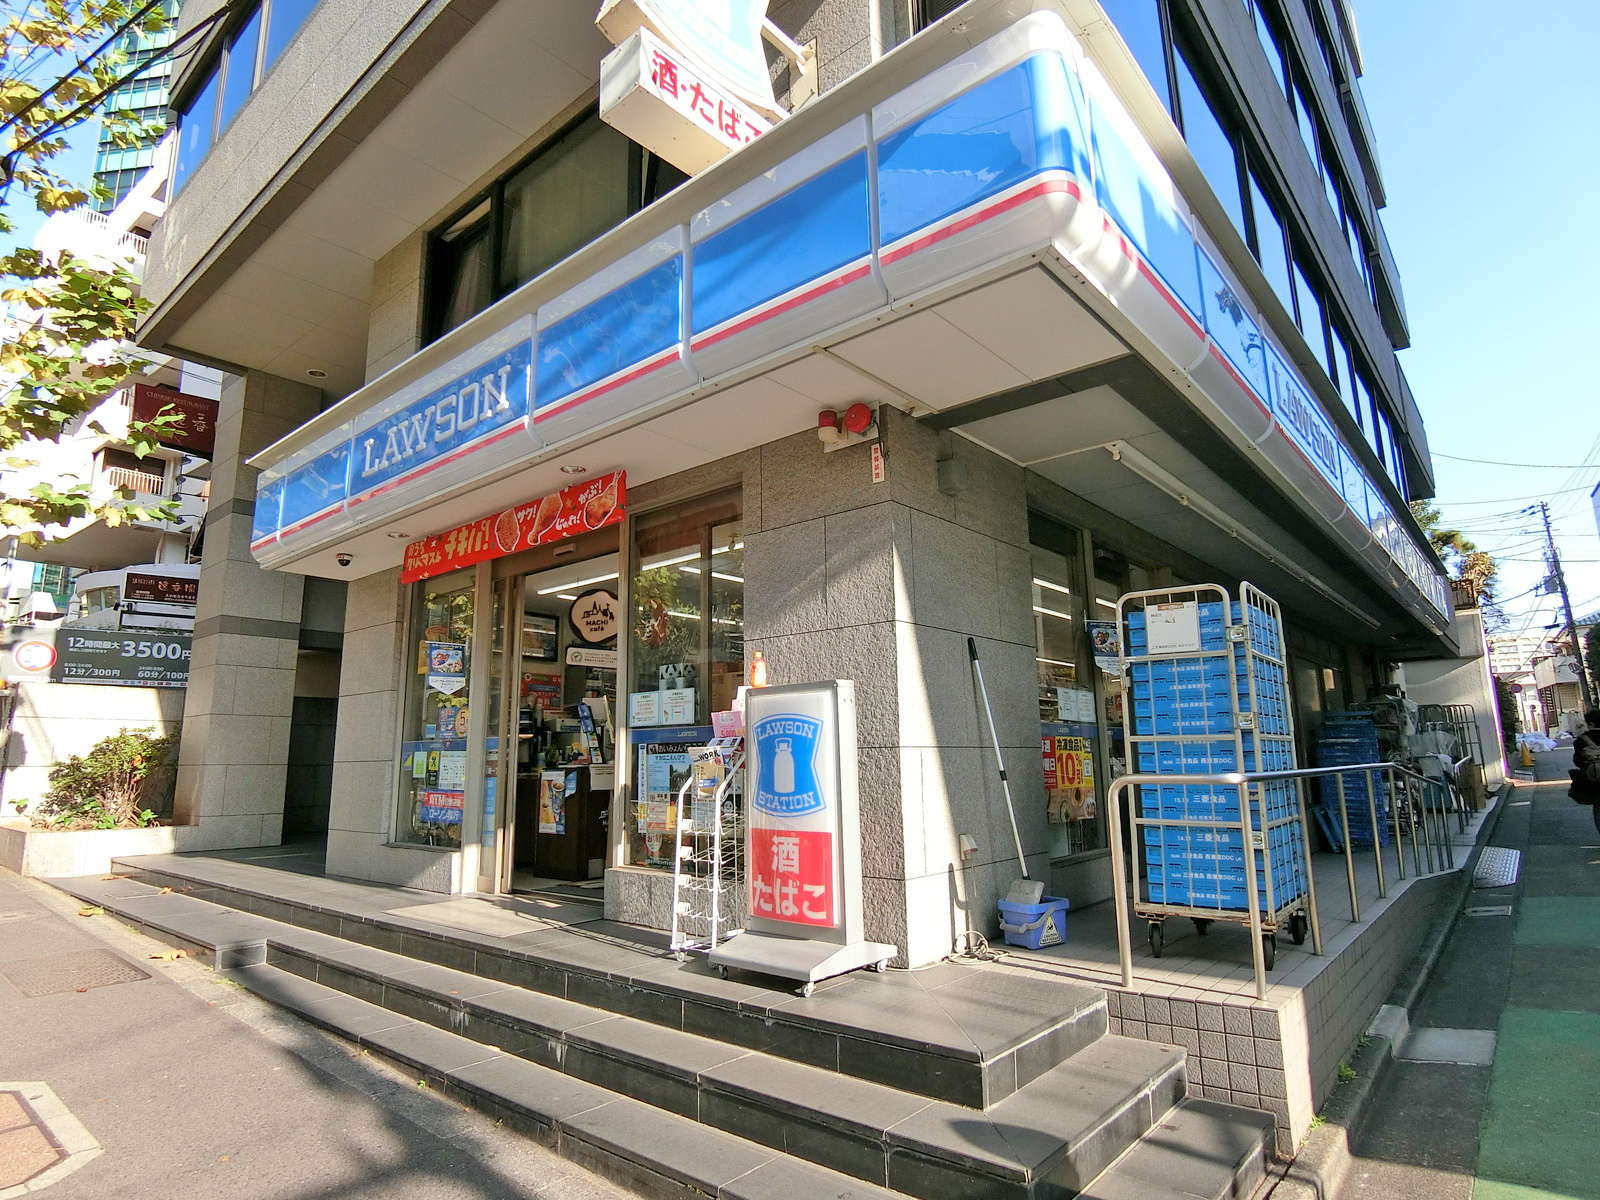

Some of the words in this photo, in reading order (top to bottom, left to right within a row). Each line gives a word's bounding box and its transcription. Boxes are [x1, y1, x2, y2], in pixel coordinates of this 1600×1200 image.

[361, 364, 512, 479] LAWSON
[1271, 361, 1338, 480] LAWSON
[67, 637, 121, 650] 12時間最大
[121, 640, 192, 660] 3500円
[757, 720, 815, 743] LAWSON
[697, 749, 720, 761] WORK
[758, 791, 816, 811] STATION
[771, 836, 800, 875] 酒
[753, 873, 827, 920] たばこ
